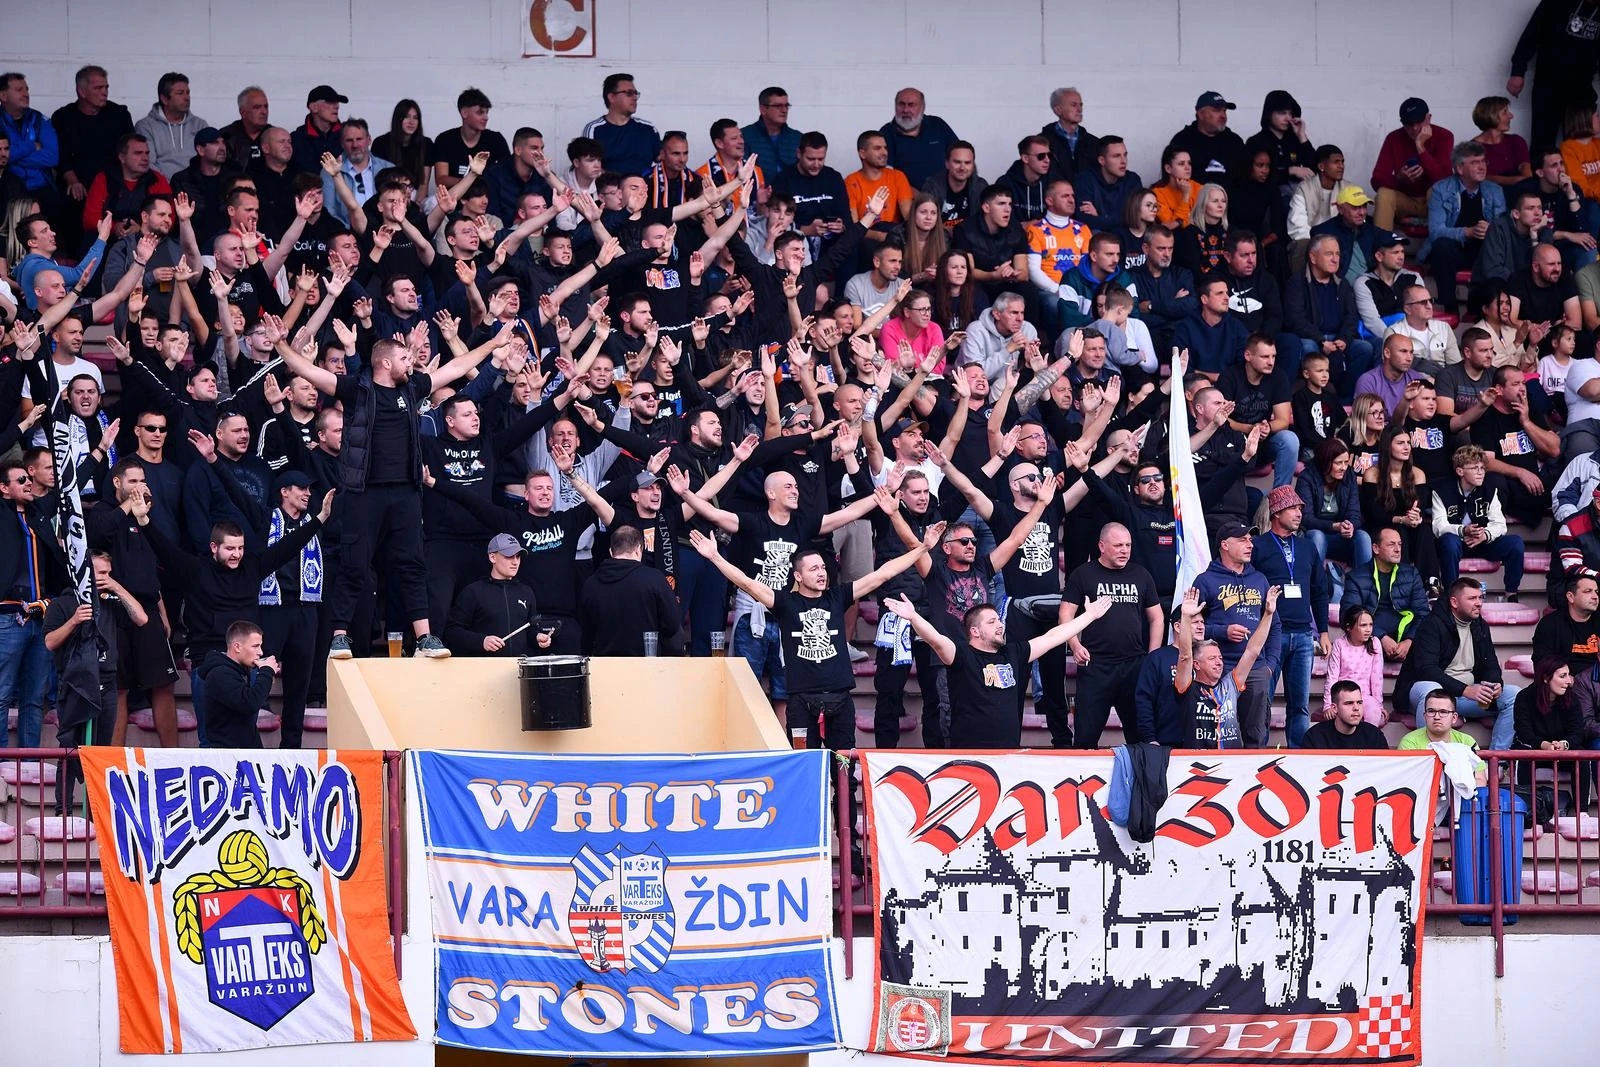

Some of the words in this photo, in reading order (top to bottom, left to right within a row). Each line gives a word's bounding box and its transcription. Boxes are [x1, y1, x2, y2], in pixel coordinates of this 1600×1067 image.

[530, 0, 587, 52] C
[1045, 236, 1057, 249] 10
[659, 526, 674, 574] AGAINST
[1096, 582, 1139, 595] ALPHA
[107, 760, 360, 883] NEDAMO
[467, 776, 777, 832] WHITE
[874, 756, 1421, 855] Varždin
[624, 861, 632, 870] N
[652, 861, 660, 870] K
[1262, 840, 1314, 864] 1181
[204, 898, 221, 917] N
[280, 894, 294, 913] K
[448, 880, 560, 930] VARA
[684, 876, 809, 932] ŽDIN
[623, 876, 662, 898] VARTEKS
[211, 922, 306, 985] VARTEKS
[216, 982, 308, 999] VARAŽDIN
[447, 976, 821, 1035] STONES
[958, 1016, 1355, 1055] UNITED
